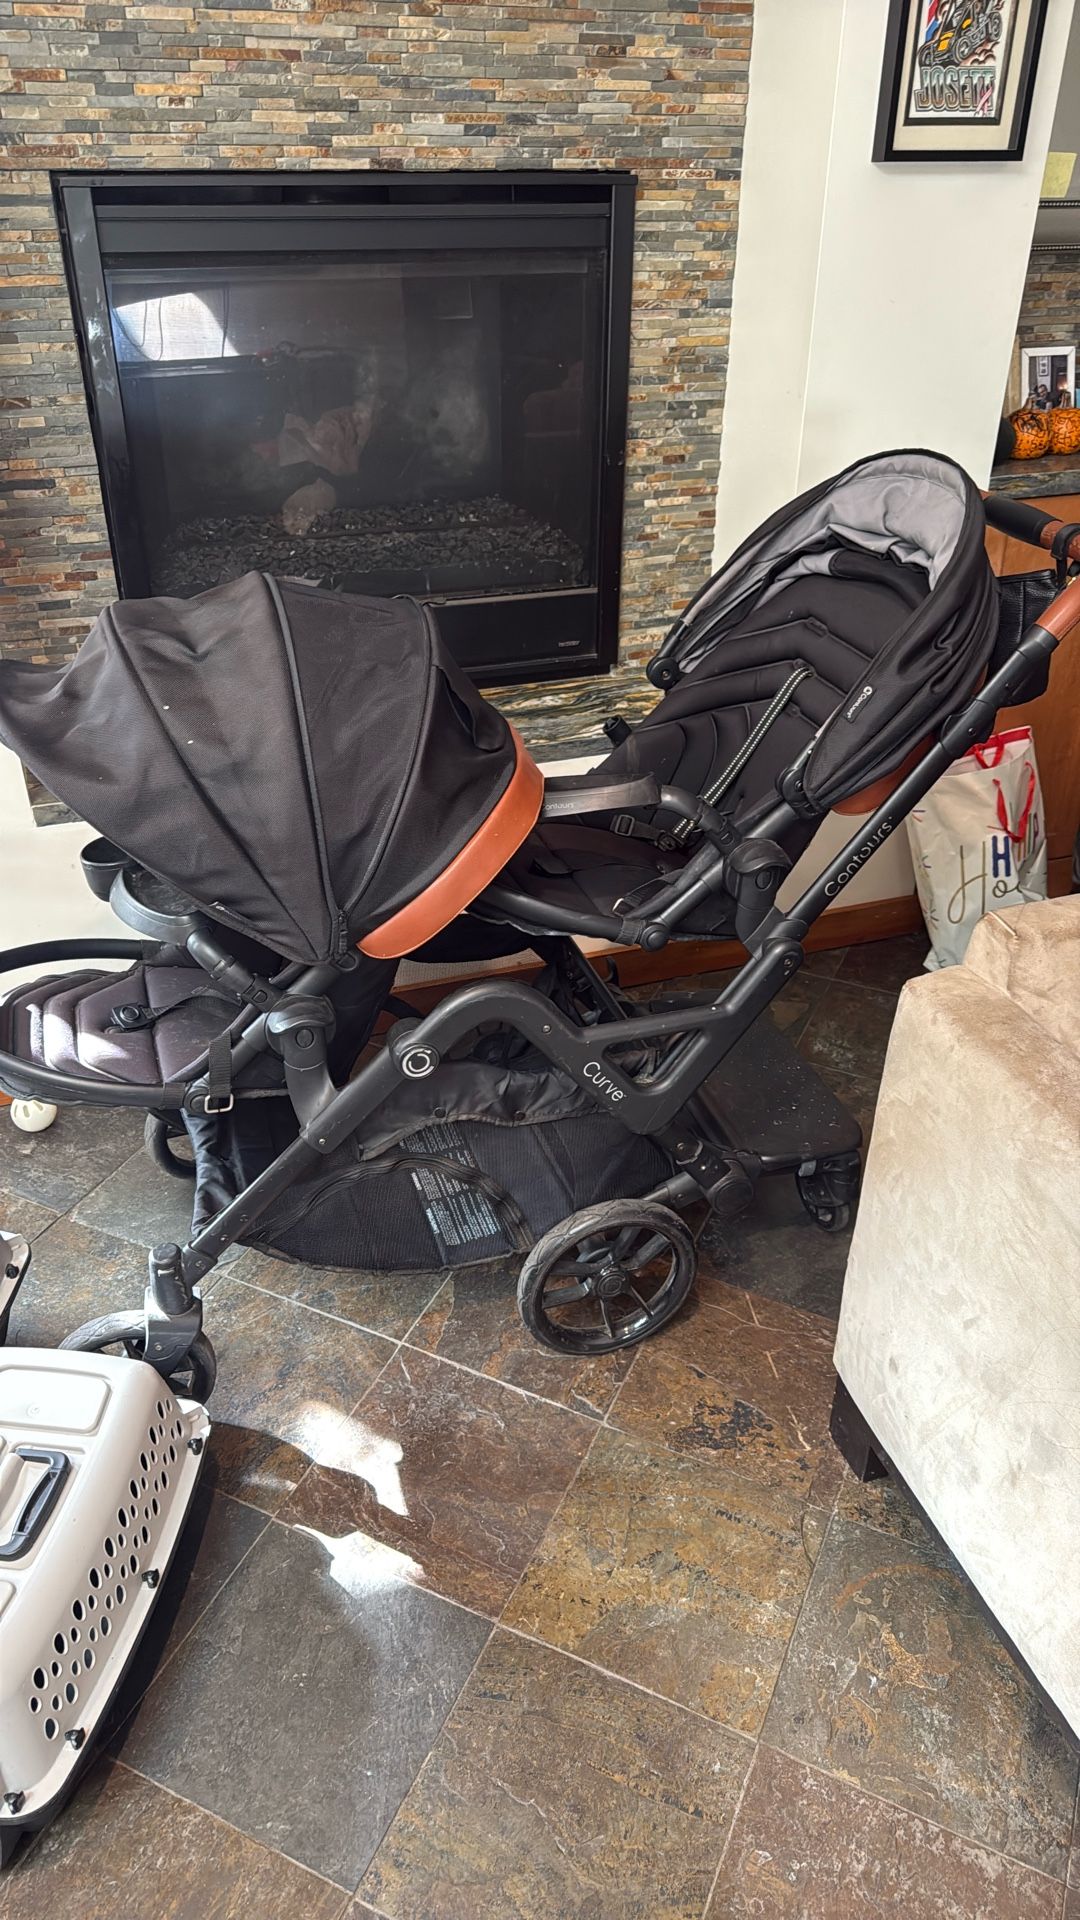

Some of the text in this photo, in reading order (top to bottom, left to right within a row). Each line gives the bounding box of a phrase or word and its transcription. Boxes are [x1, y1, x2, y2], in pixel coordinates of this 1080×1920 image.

[543, 802, 575, 810] ontours
[824, 822, 893, 897] Contours
[583, 1061, 624, 1101] Curve
